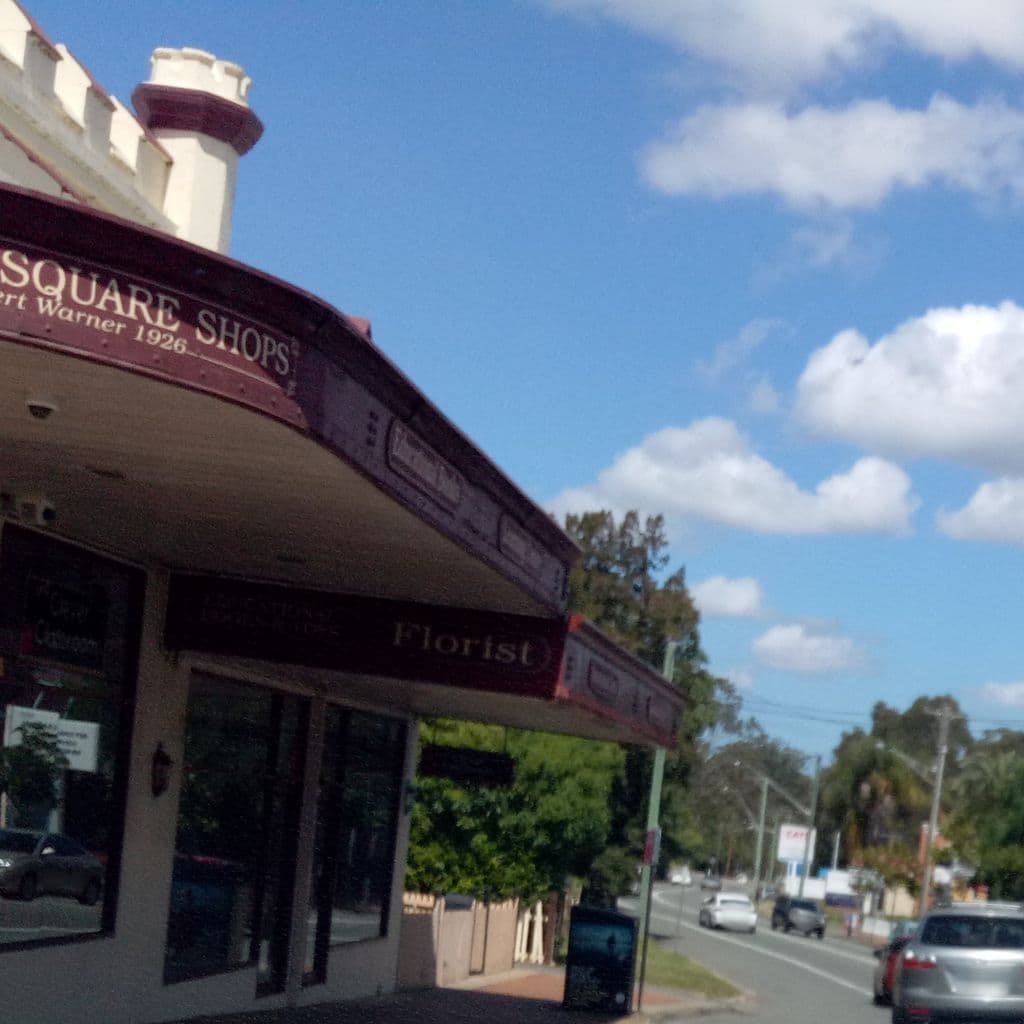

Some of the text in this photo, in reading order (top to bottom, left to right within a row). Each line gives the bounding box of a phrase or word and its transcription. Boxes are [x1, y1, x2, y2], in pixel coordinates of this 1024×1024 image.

[0, 250, 290, 376] SQUARE SHOPS
[36, 297, 127, 336] Warner
[135, 325, 188, 355] 1926
[392, 620, 533, 667] Florist
